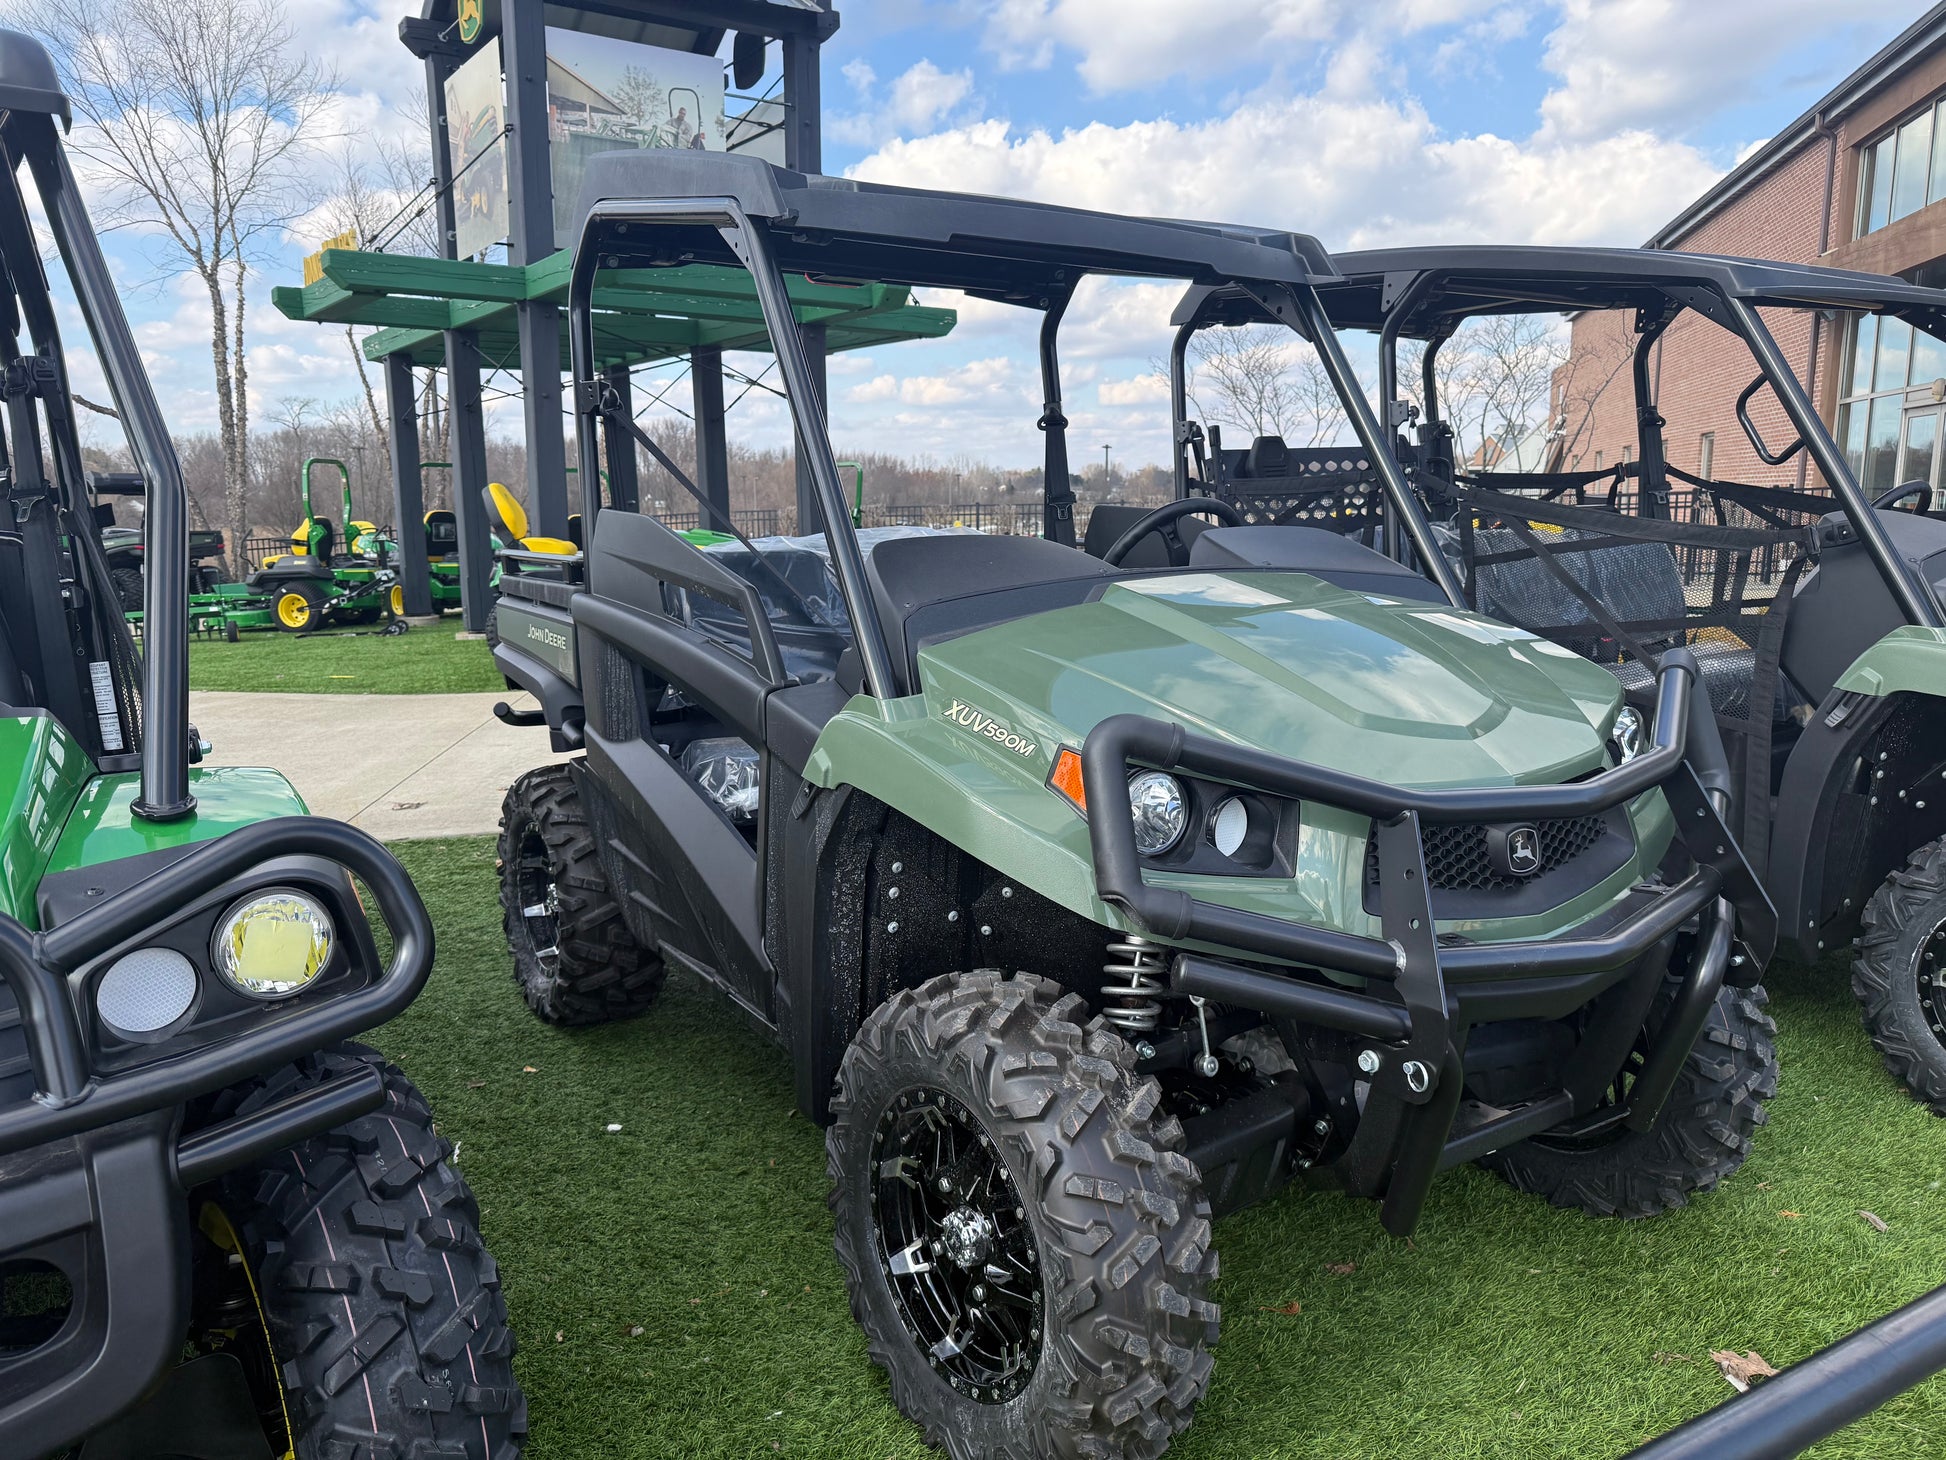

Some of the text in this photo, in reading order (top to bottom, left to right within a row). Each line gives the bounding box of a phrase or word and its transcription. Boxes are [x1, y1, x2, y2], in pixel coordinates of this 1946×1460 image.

[527, 624, 566, 650] JOHN DEERE
[942, 698, 1037, 758] XUV590M
